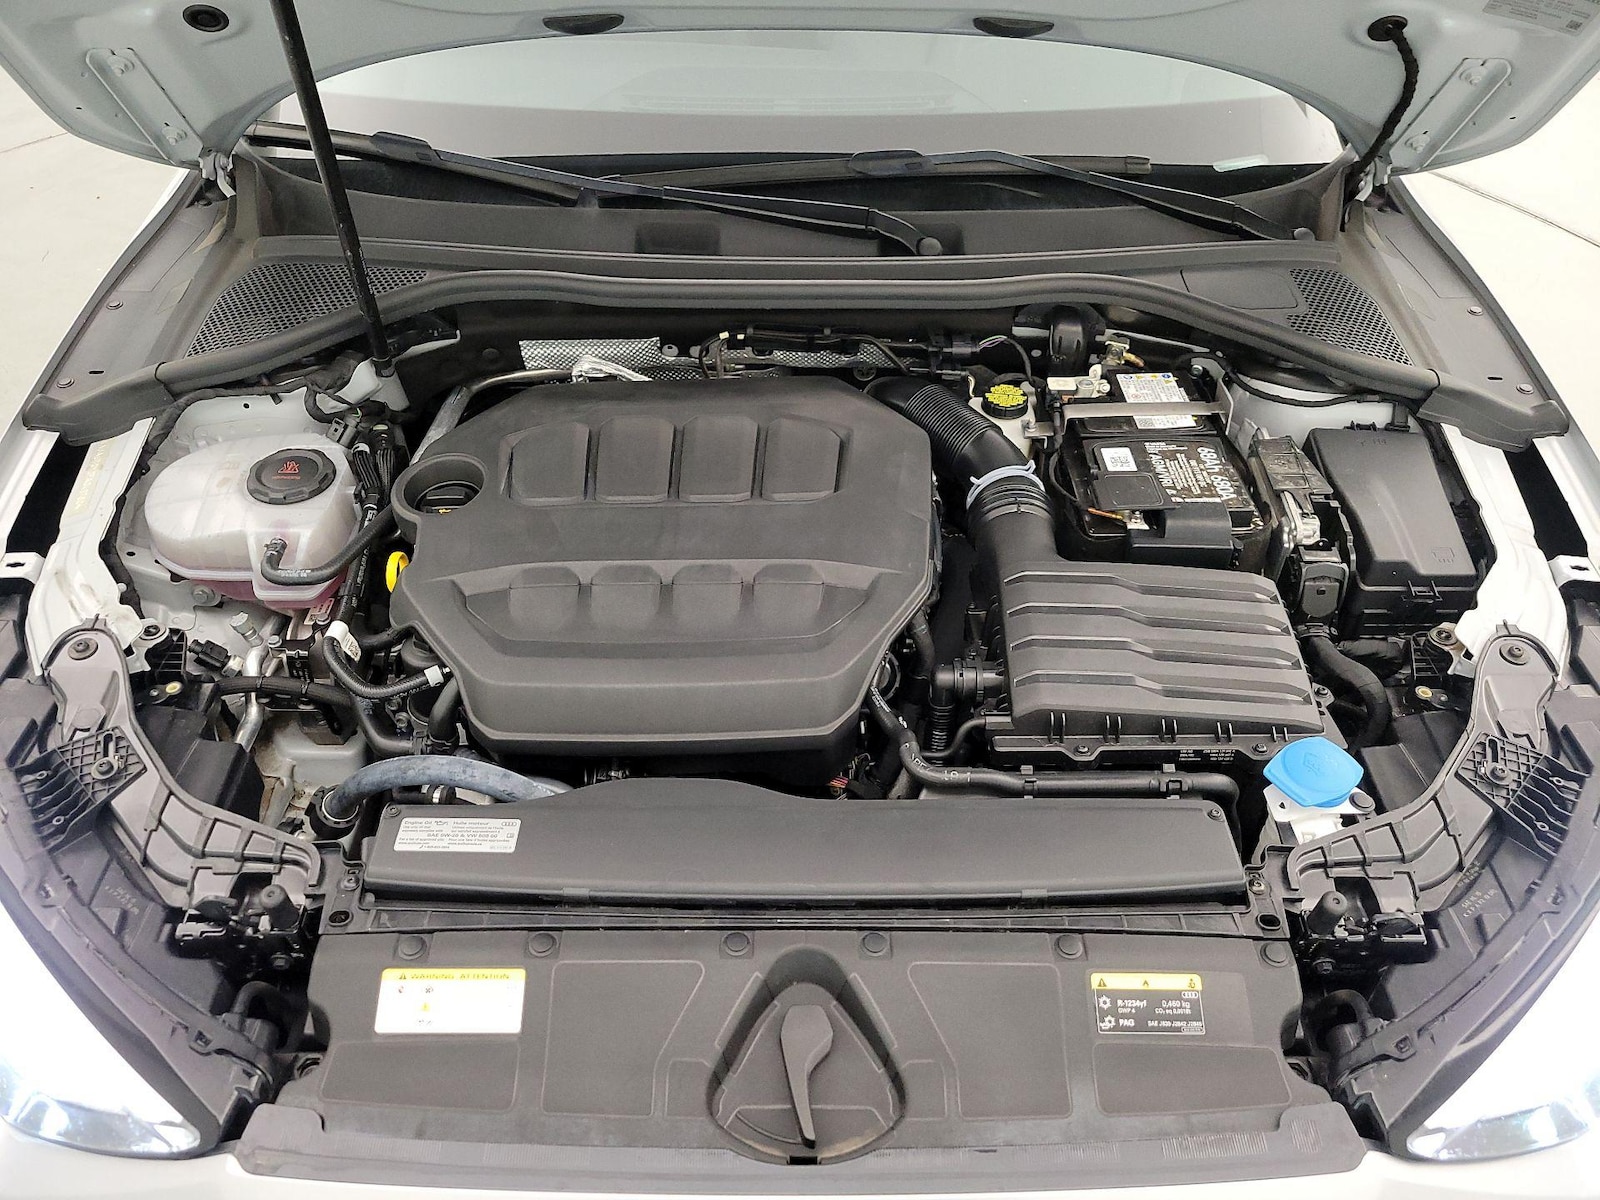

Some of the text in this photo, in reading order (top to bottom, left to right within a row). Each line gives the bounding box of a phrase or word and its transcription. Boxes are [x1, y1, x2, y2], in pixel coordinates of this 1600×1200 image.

[1197, 446, 1222, 473] 68Ah
[1210, 474, 1237, 500] 680A
[1117, 999, 1147, 1008] R-1234yf
[1181, 1000, 1191, 1009] kg
[1119, 1018, 1135, 1027] PAG
